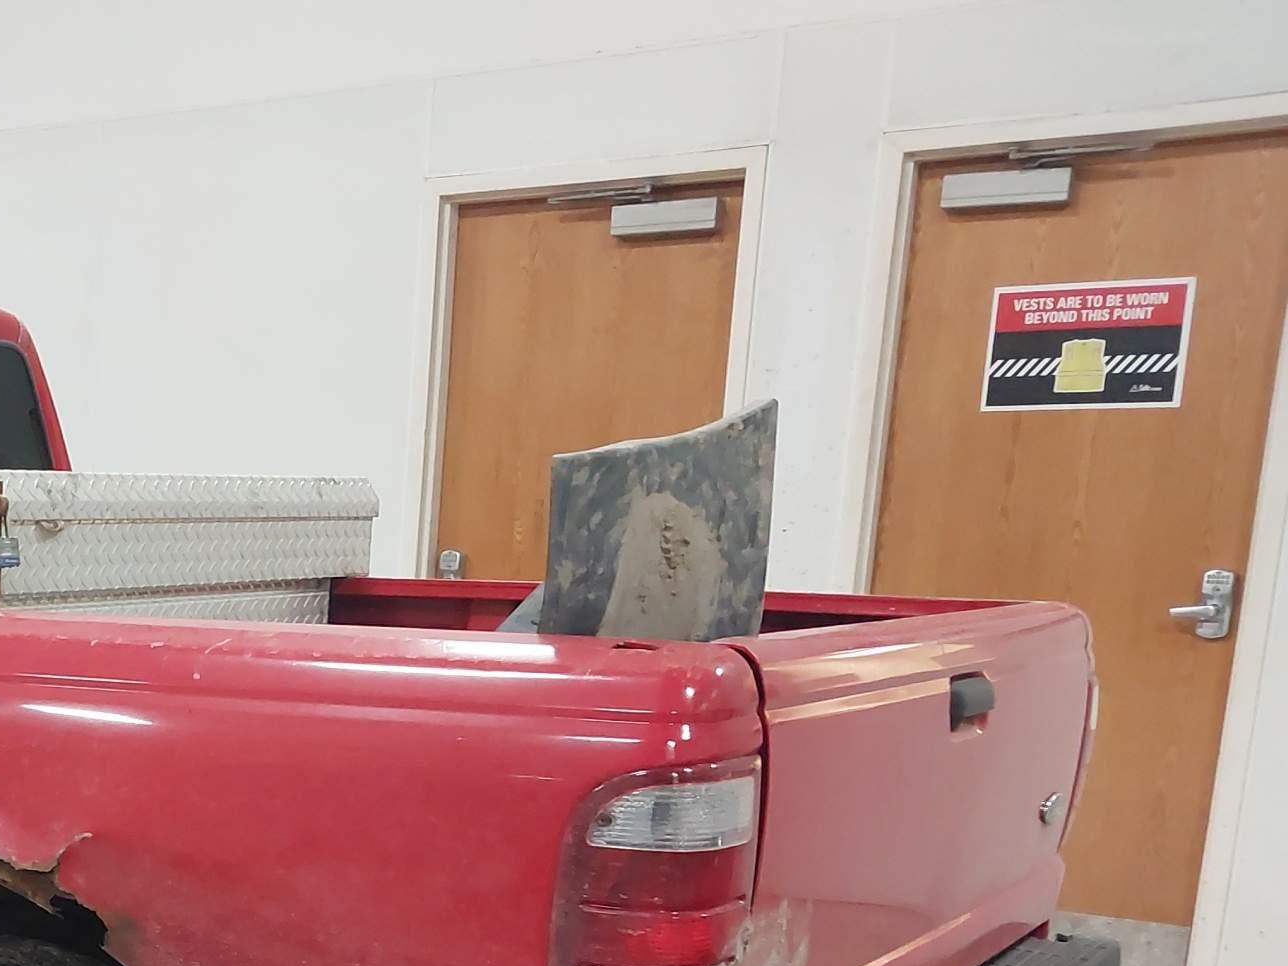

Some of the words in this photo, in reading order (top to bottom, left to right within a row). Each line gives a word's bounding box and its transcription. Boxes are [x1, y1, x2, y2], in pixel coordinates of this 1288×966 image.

[1013, 297, 1055, 312] VESTS
[1056, 296, 1083, 310] ARE
[1086, 295, 1104, 308] TO
[1105, 294, 1123, 307] BE
[1125, 292, 1169, 306] WORN
[1024, 310, 1078, 325] BEYOND
[1080, 308, 1110, 322] THIS
[1112, 306, 1155, 321] POINT
